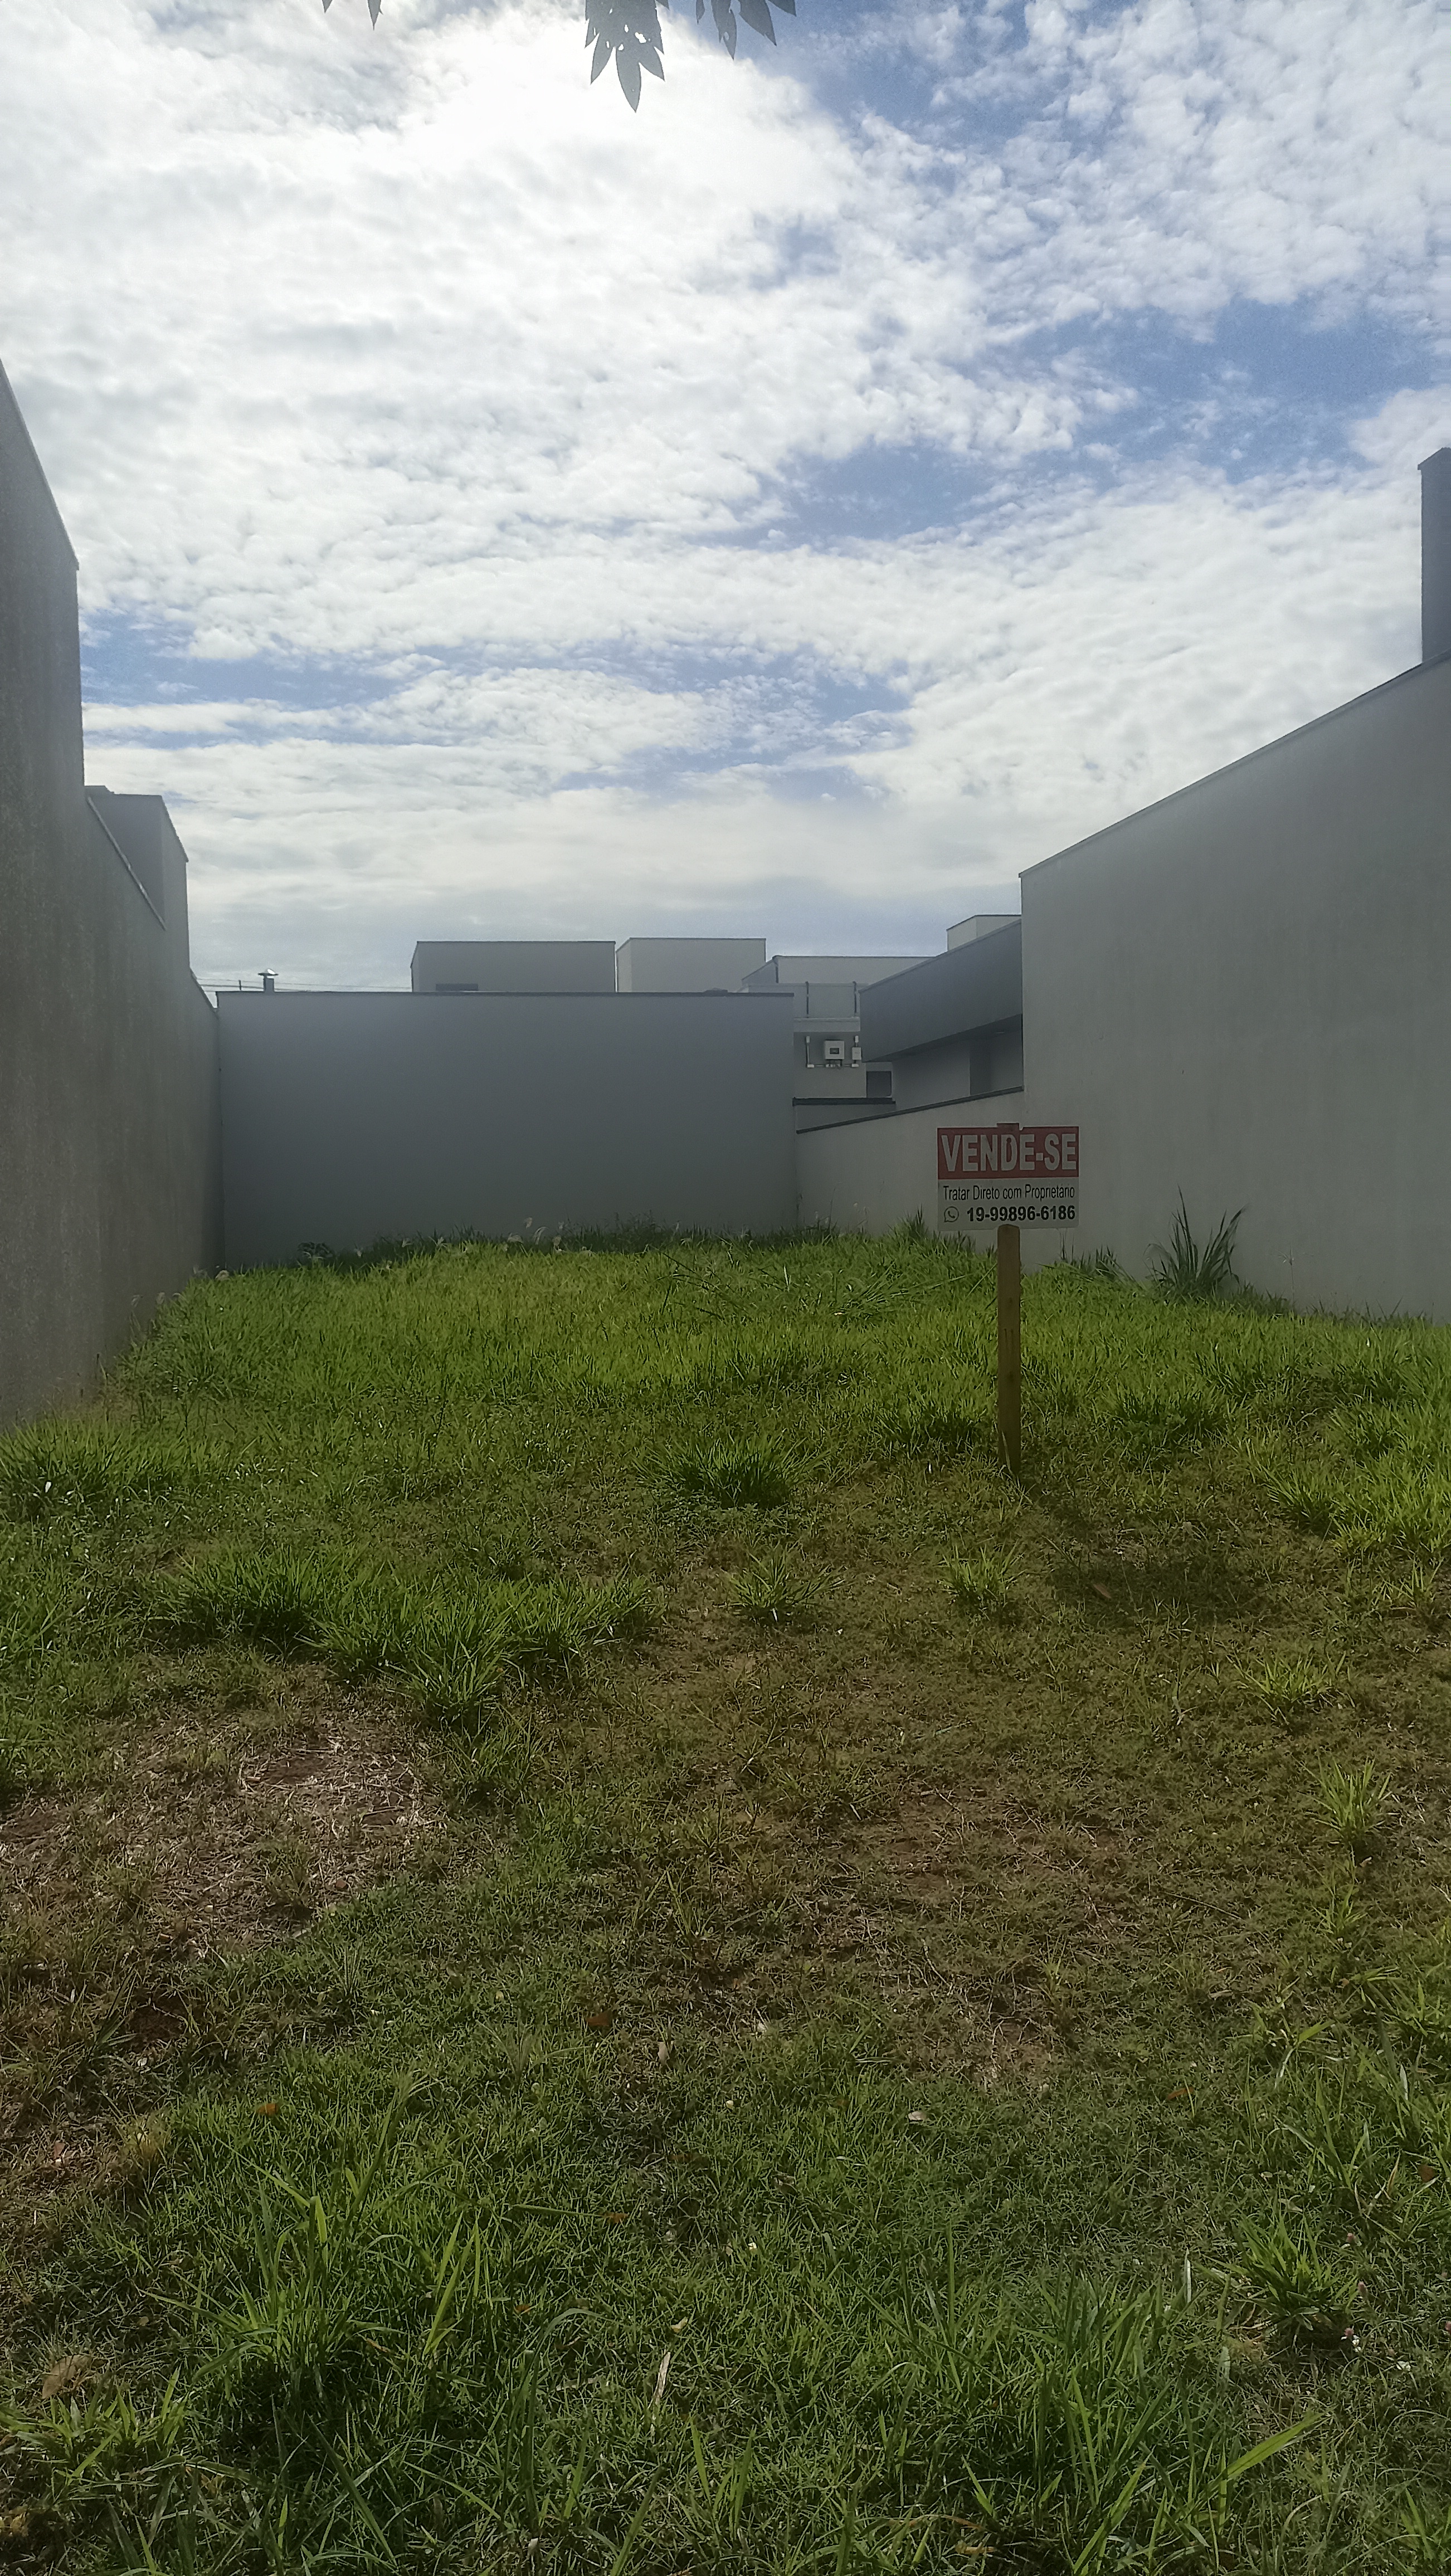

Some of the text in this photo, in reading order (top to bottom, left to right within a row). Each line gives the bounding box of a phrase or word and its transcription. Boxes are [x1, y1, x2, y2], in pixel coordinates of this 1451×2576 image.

[941, 1133, 1077, 1172] VENDE-SE
[943, 1185, 970, 1201] Tratar
[973, 1185, 1000, 1200] Direto
[1002, 1188, 1022, 1199] com
[967, 1205, 1075, 1222] 19-99896-6186
